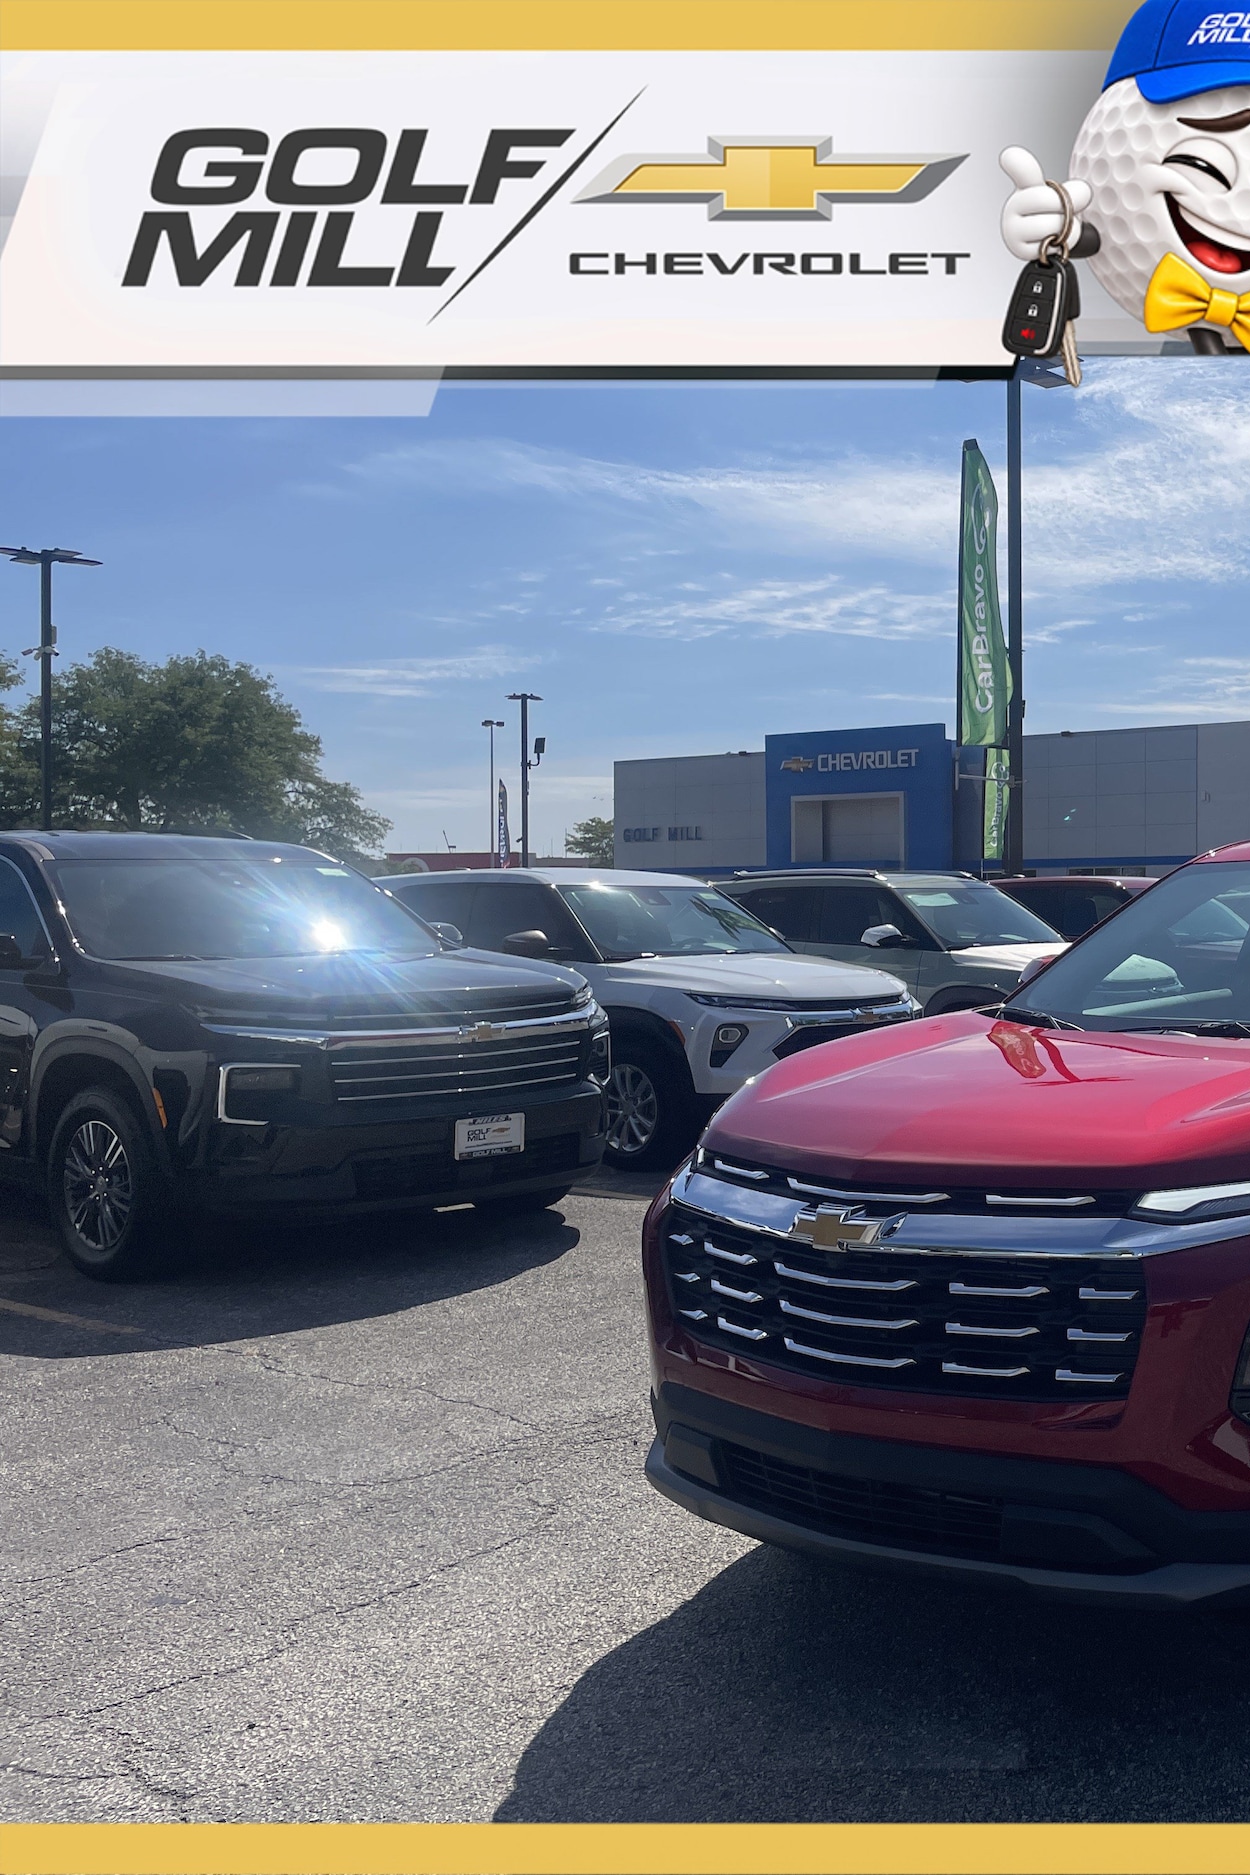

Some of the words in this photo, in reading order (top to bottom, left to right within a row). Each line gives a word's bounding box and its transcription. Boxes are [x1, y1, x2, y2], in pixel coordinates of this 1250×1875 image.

[972, 563, 994, 713] CarBravo
[817, 748, 919, 773] CHEVROLET
[622, 827, 660, 843] GOLF
[667, 825, 703, 842] MILL
[467, 1127, 491, 1137] GOLF
